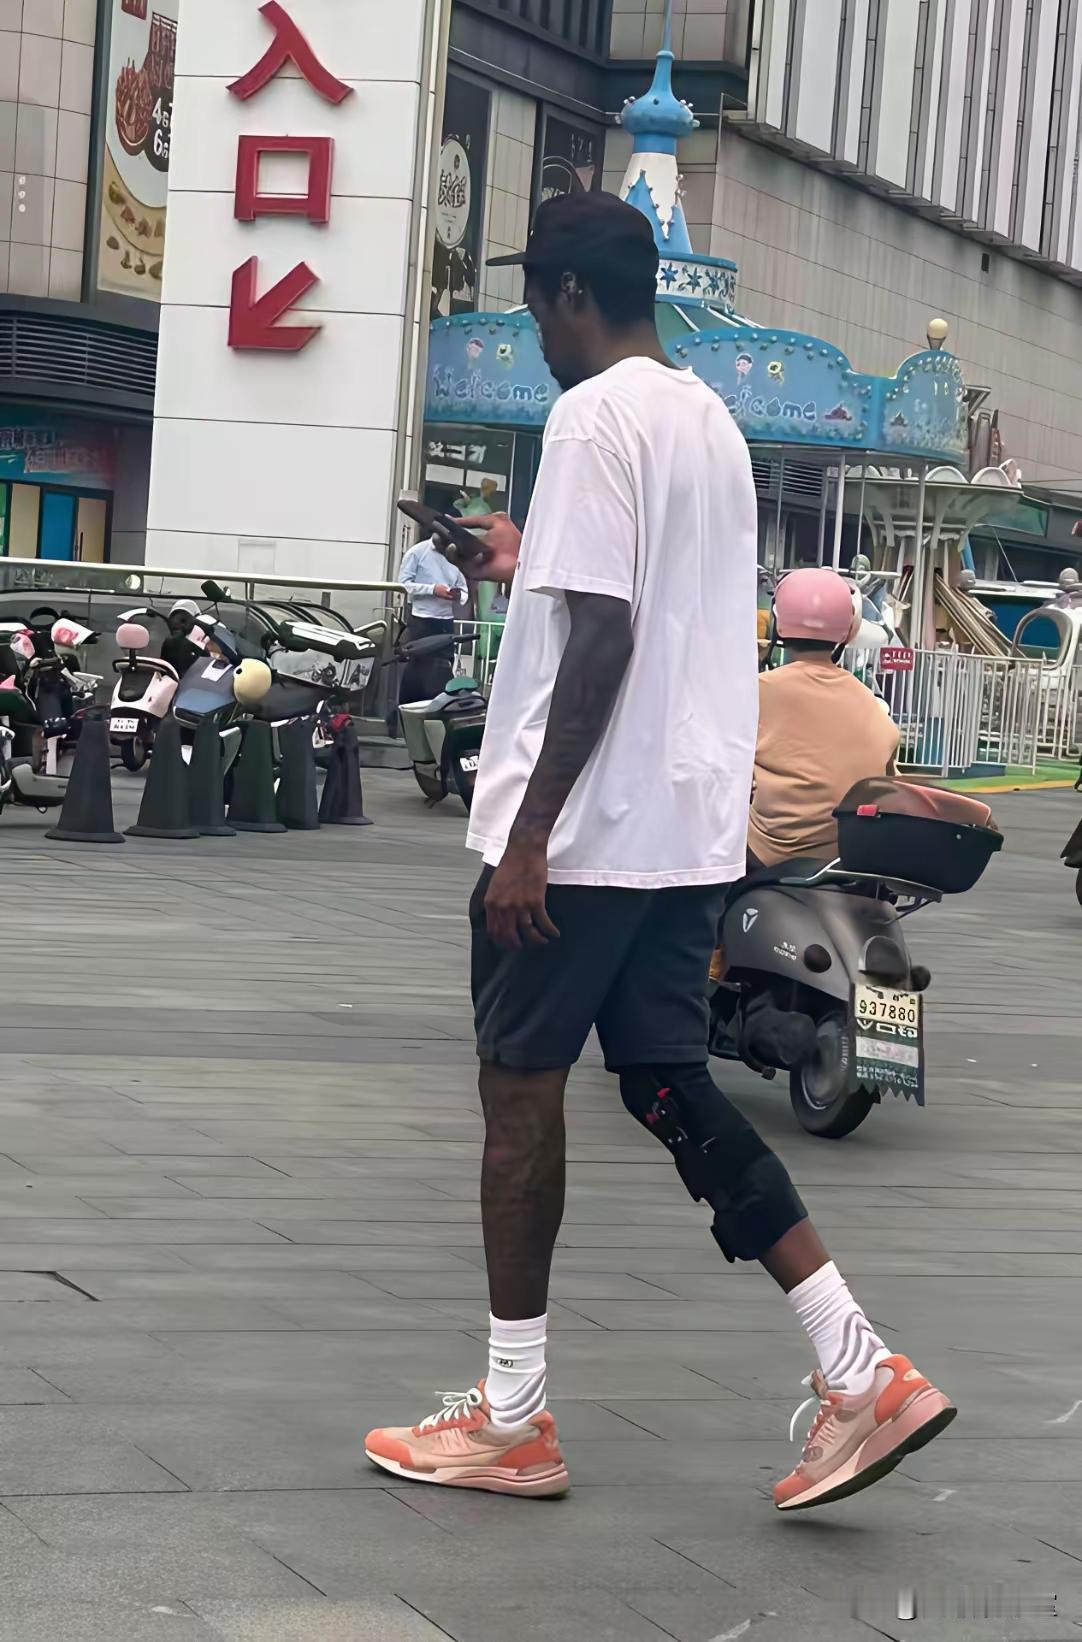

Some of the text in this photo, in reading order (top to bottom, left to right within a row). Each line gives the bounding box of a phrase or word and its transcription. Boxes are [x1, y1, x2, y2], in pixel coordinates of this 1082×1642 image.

[225, 0, 354, 222] 入口
[716, 385, 817, 423] elcome
[859, 999, 915, 1023] 937880
